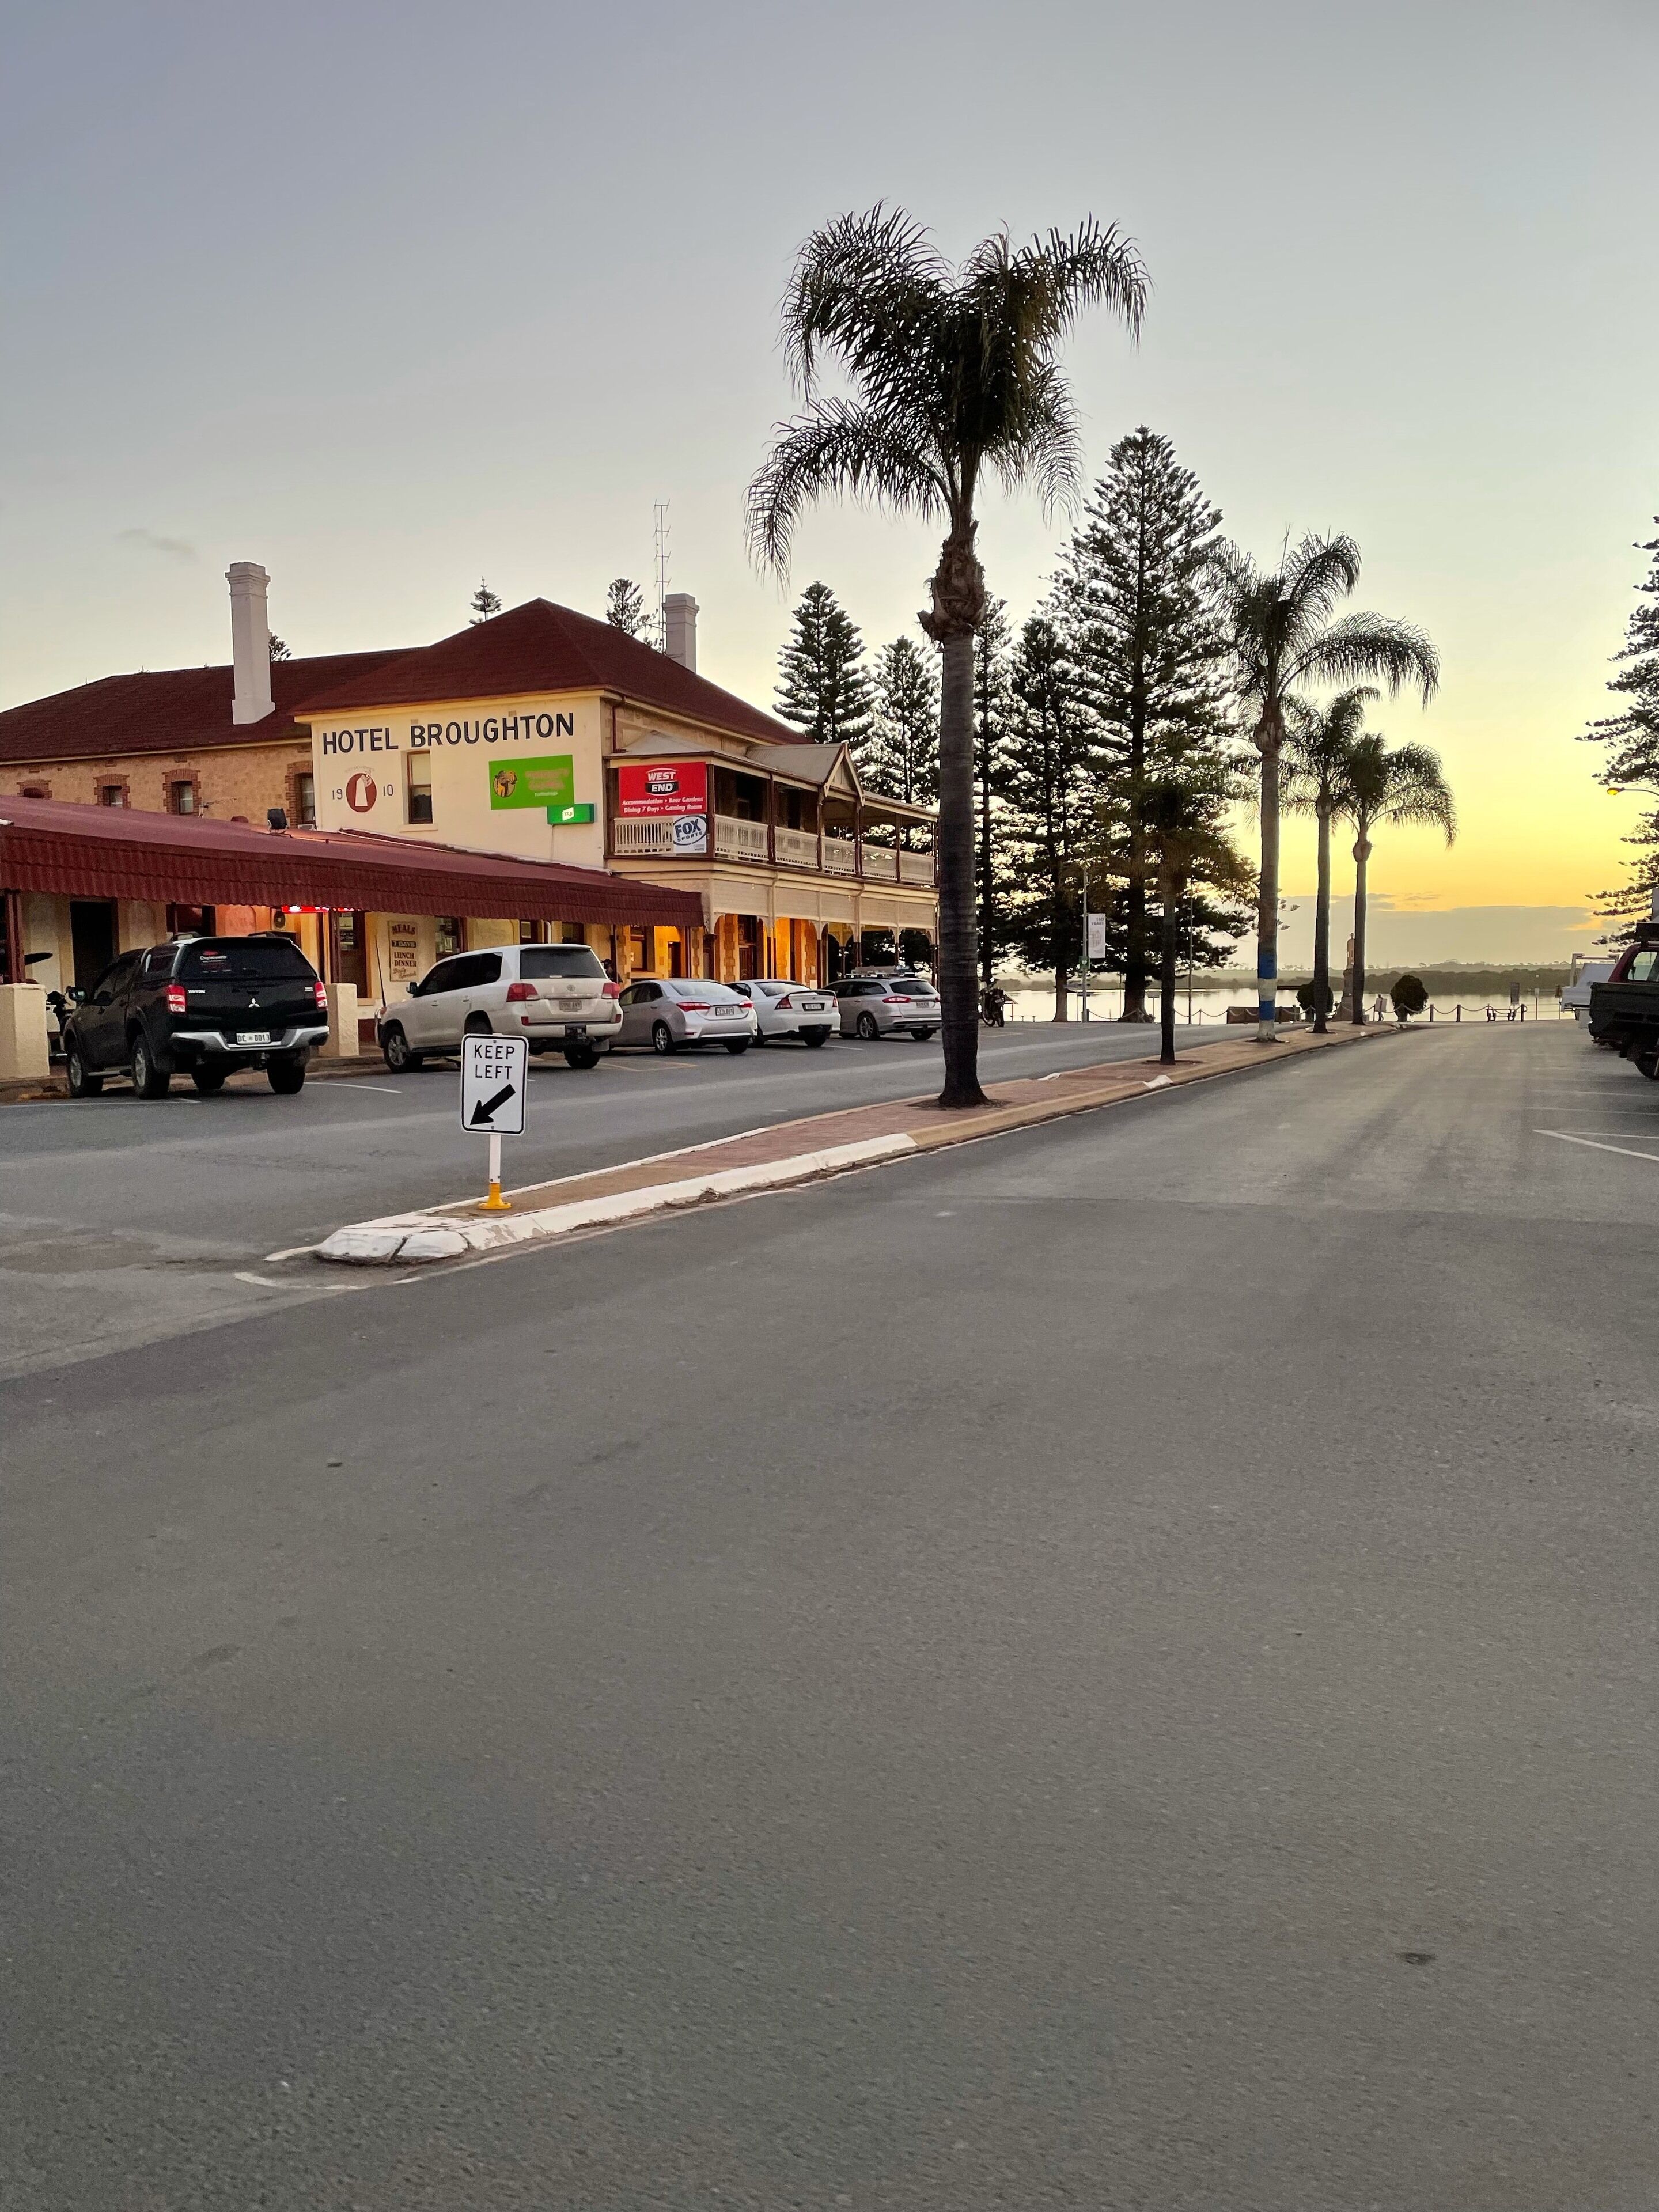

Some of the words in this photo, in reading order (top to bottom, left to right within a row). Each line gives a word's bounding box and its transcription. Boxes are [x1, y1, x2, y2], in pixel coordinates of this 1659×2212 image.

[323, 728, 399, 755] HOTEL
[411, 713, 574, 748] BROUGHTON
[647, 772, 676, 781] WEST
[332, 788, 343, 800] 19
[383, 784, 393, 796] 10
[651, 784, 673, 792] END
[675, 818, 702, 838] FOX
[677, 831, 702, 842] SPORTS
[392, 923, 415, 935] MEALS
[394, 951, 415, 959] LUNCH
[474, 1044, 514, 1060] KEEP
[475, 1065, 512, 1080] LEFT
